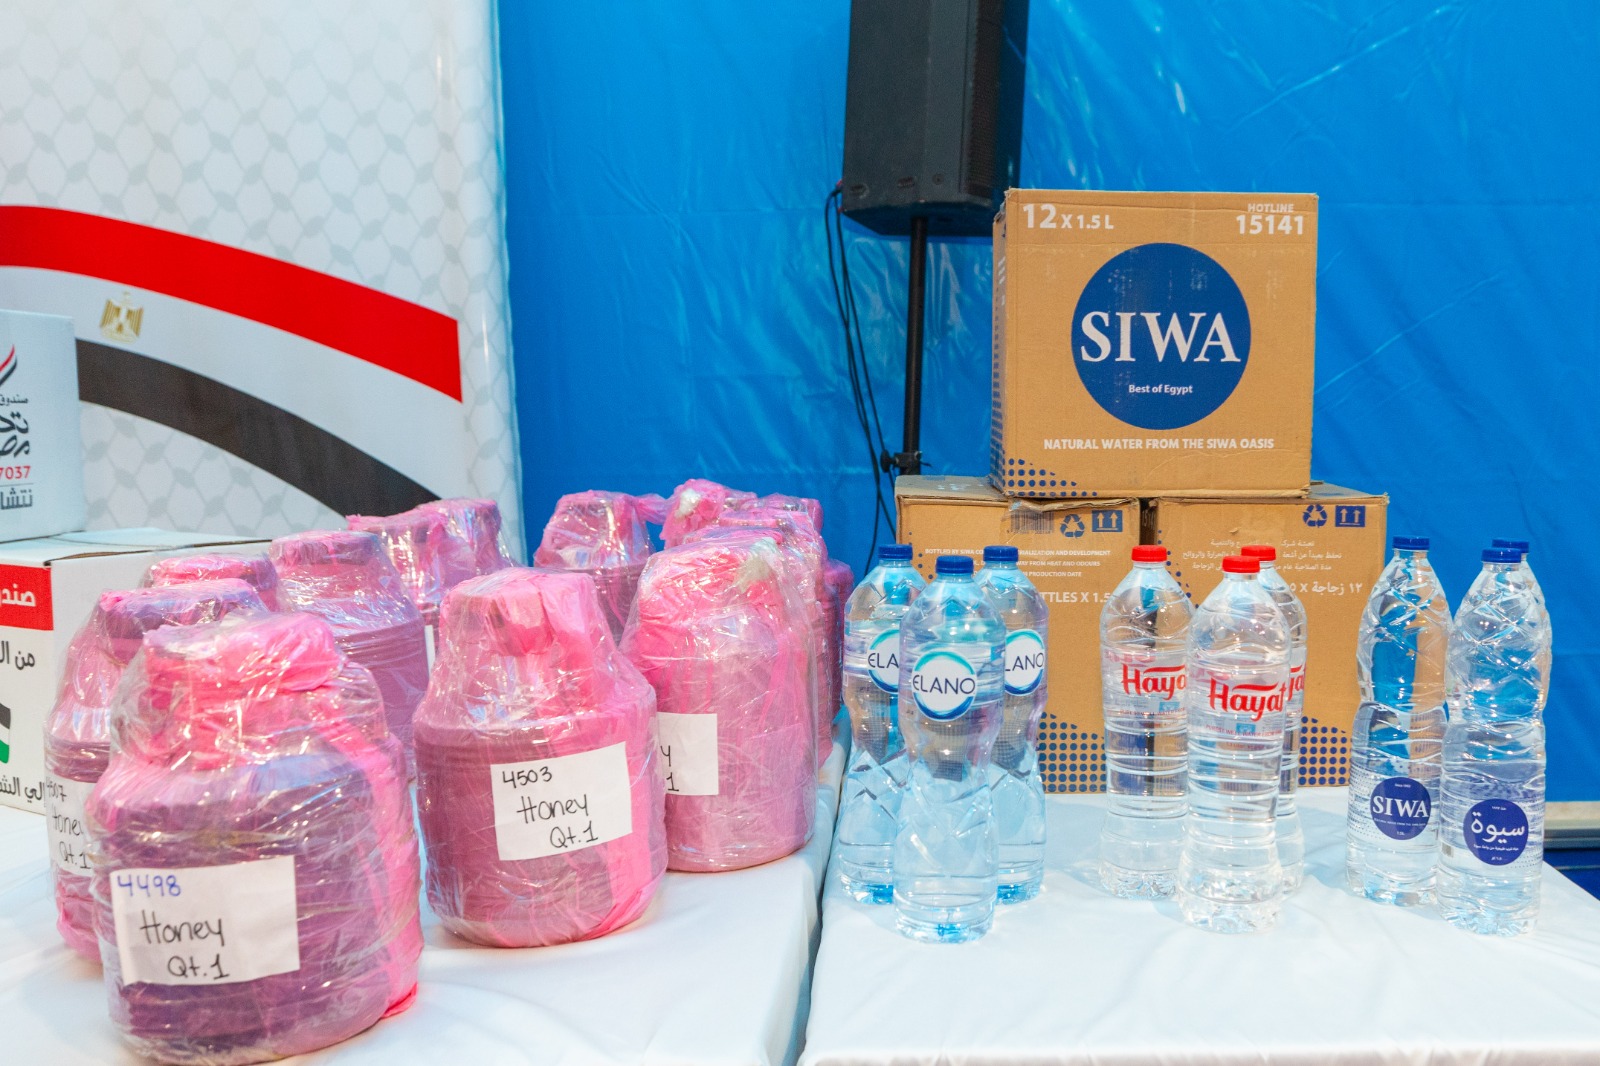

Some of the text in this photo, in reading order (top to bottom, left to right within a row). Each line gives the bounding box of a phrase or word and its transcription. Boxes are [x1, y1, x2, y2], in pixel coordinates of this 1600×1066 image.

[1023, 203, 1115, 230] 12 X 1.5 L
[1247, 203, 1295, 214] HOTLINE
[1236, 215, 1305, 235] 15141
[1080, 310, 1241, 363] SIWA
[1128, 384, 1193, 396] Best of Egypt
[1044, 438, 1275, 450] NATURAL WATER FROM THE SIWA OASIS
[0, 487, 33, 511] نتشا
[1041, 591, 1078, 603] TTLES
[1080, 591, 1090, 603] X
[1311, 580, 1345, 596] زجاجة
[14, 650, 36, 671] من
[867, 652, 899, 669] ELA
[912, 674, 976, 695] ELANO
[1121, 662, 1187, 701] Haya
[1208, 676, 1287, 722] Hayat
[0, 774, 21, 797] الش
[501, 765, 553, 789] 4503
[516, 793, 590, 824] Honey
[1372, 795, 1430, 818] SIWA
[1471, 811, 1525, 843] سيوة
[116, 873, 182, 898] 4498
[139, 909, 226, 947] Honey
